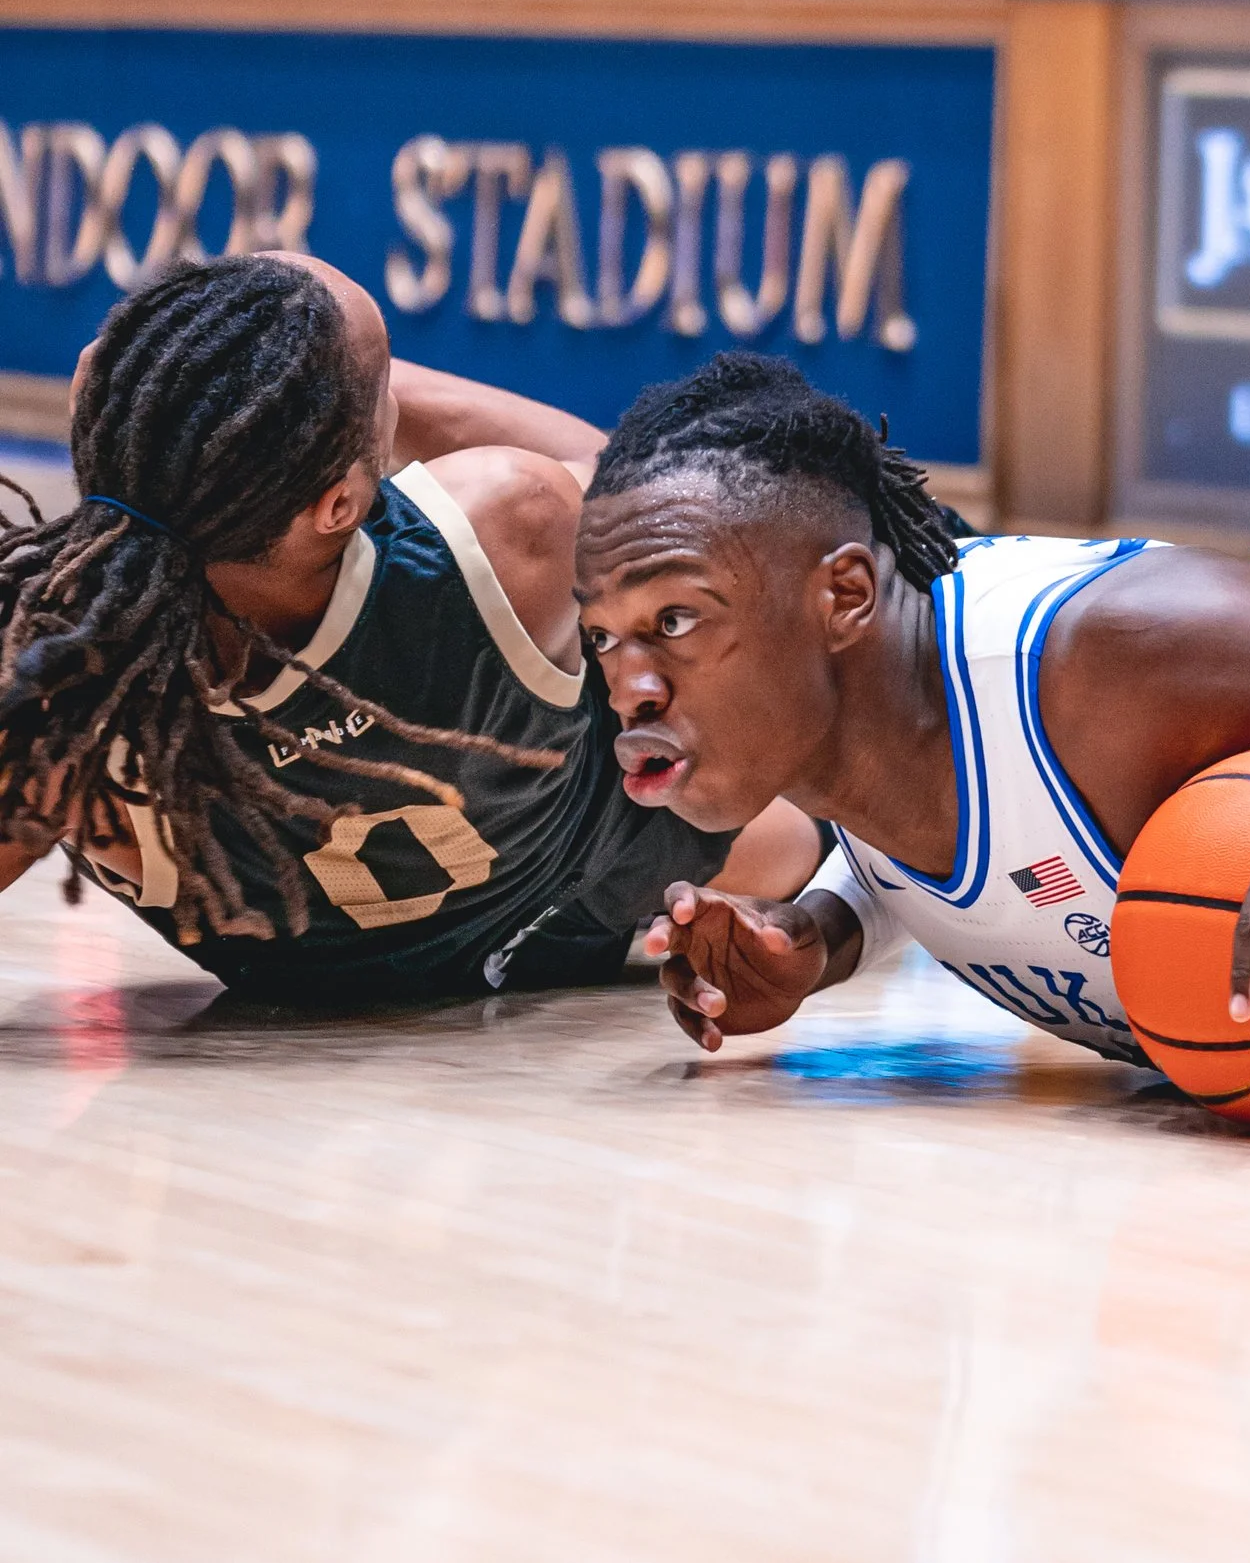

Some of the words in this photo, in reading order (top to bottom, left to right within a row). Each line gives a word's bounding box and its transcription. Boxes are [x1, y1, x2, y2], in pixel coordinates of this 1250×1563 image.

[385, 132, 917, 352] STADIUM
[280, 715, 364, 756] PMBROKE
[304, 805, 498, 929] 0
[937, 959, 1132, 1033] UK
